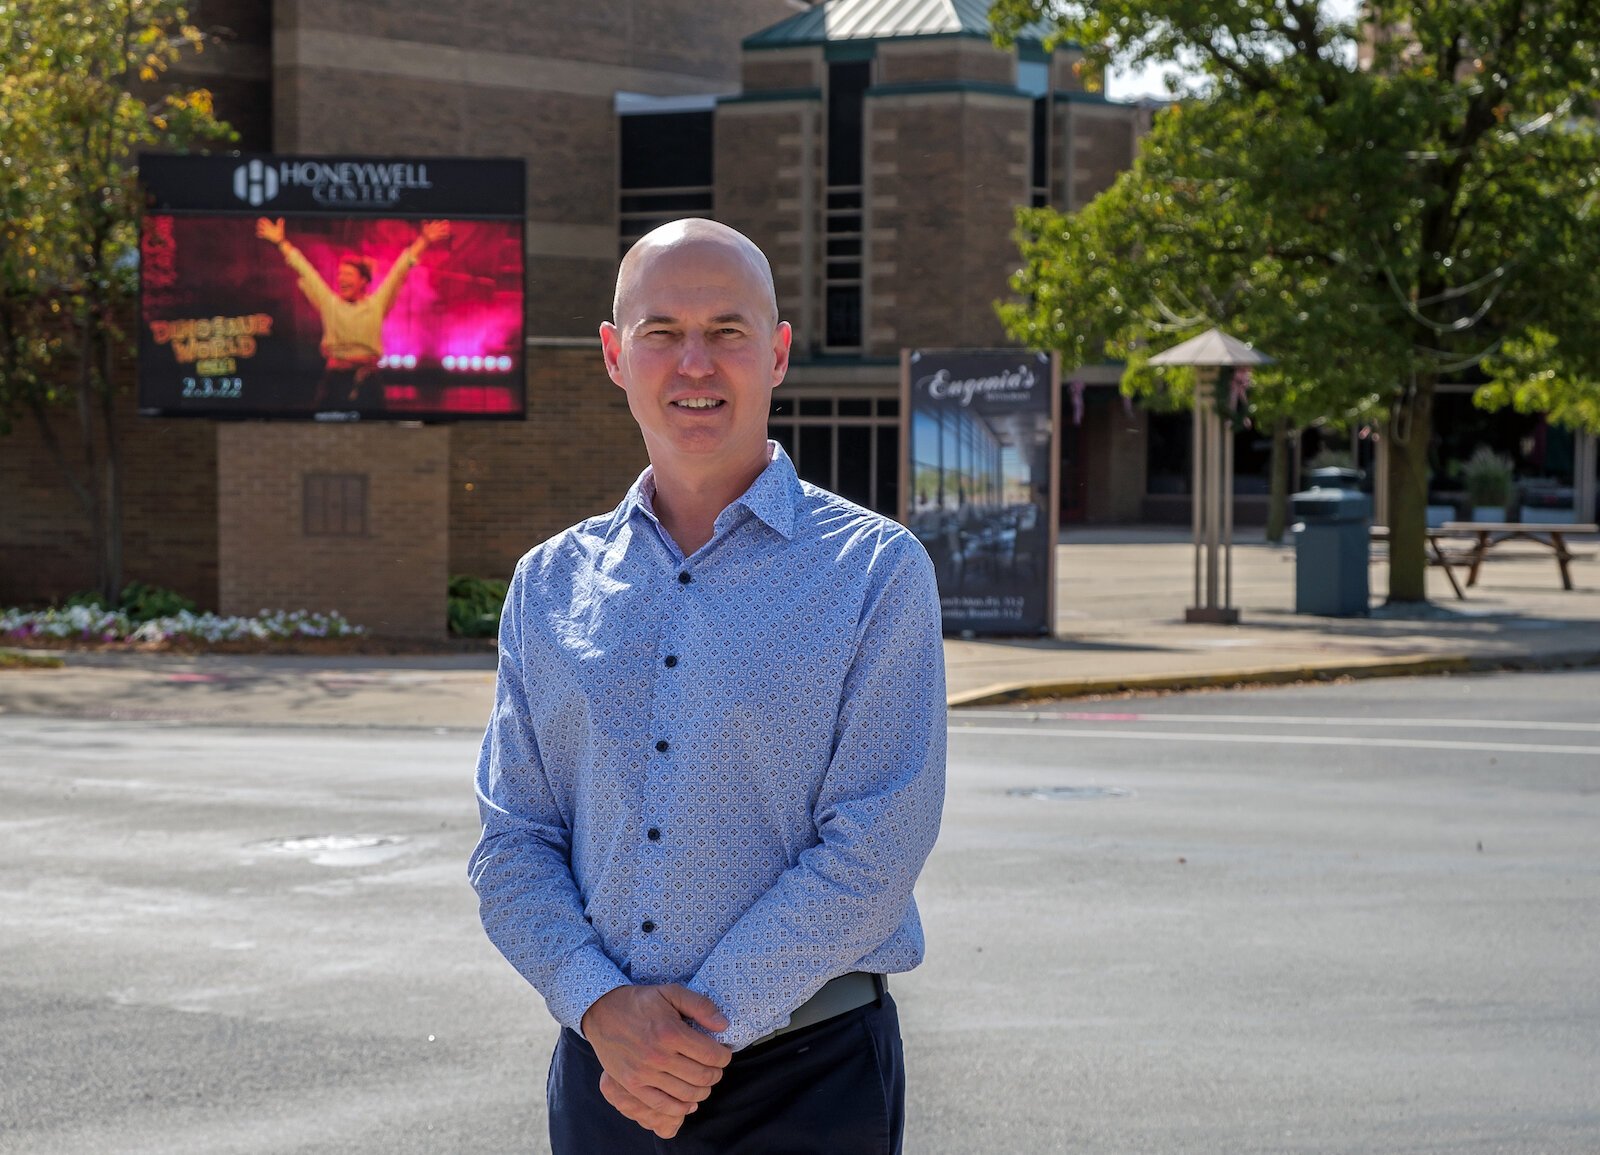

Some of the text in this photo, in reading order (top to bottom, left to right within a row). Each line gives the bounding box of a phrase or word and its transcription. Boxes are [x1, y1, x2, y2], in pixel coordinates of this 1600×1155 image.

[279, 162, 432, 187] HONEYWELL
[312, 184, 400, 202] CENTER
[150, 315, 273, 343] DINOSAUR
[173, 337, 256, 362] WORLD
[182, 377, 242, 398] 2.3.22
[914, 364, 1036, 408] Eugenia's
